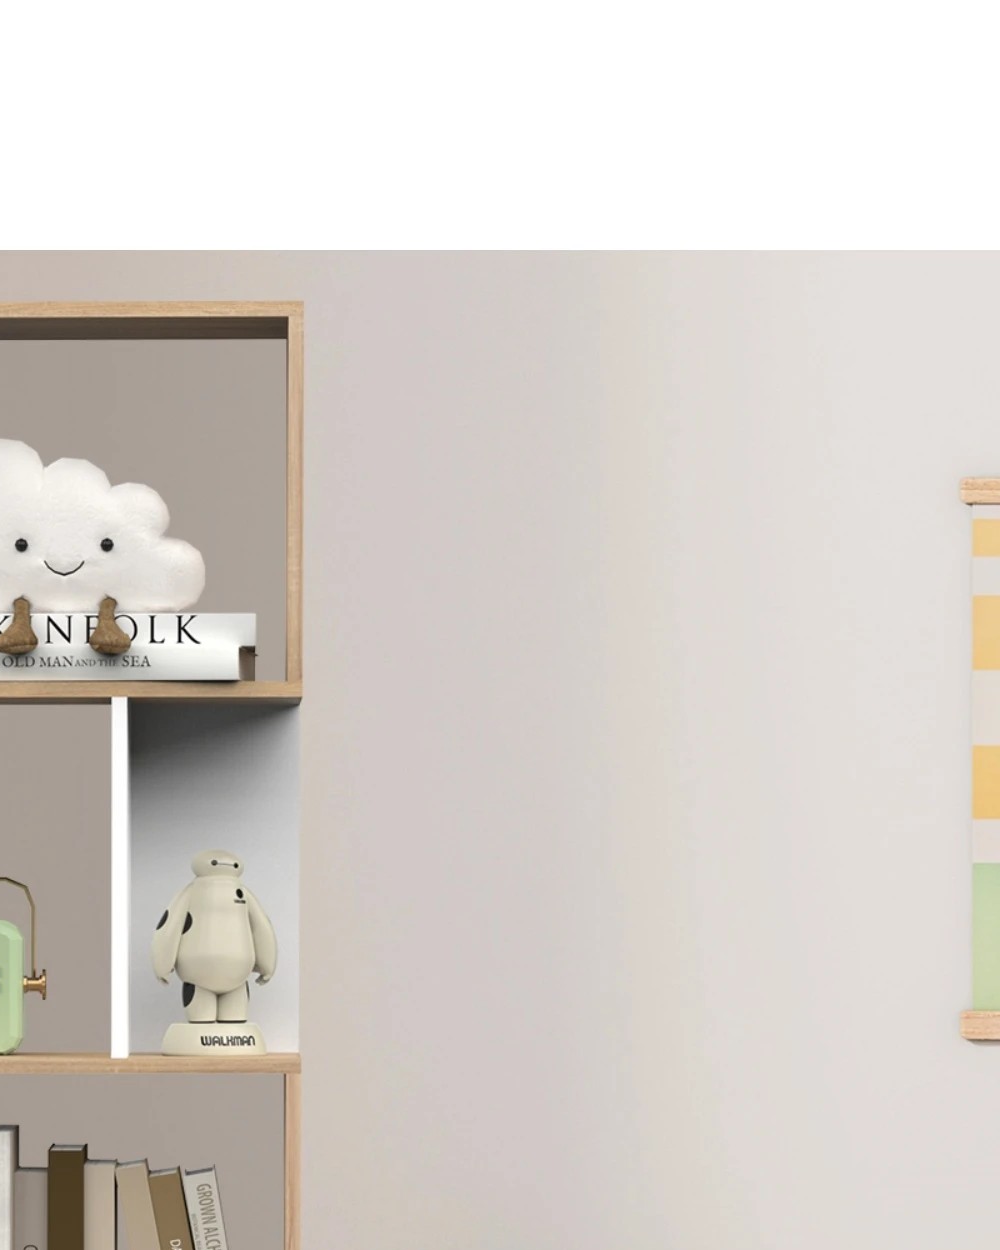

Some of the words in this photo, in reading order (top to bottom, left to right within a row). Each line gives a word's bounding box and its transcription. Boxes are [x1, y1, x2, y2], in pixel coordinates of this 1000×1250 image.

[2, 655, 36, 669] OLD
[39, 655, 75, 669] MAN
[75, 659, 97, 668] AND
[121, 654, 152, 668] SEA
[200, 1035, 256, 1047] WALKMAN
[195, 1183, 215, 1225] GROWN
